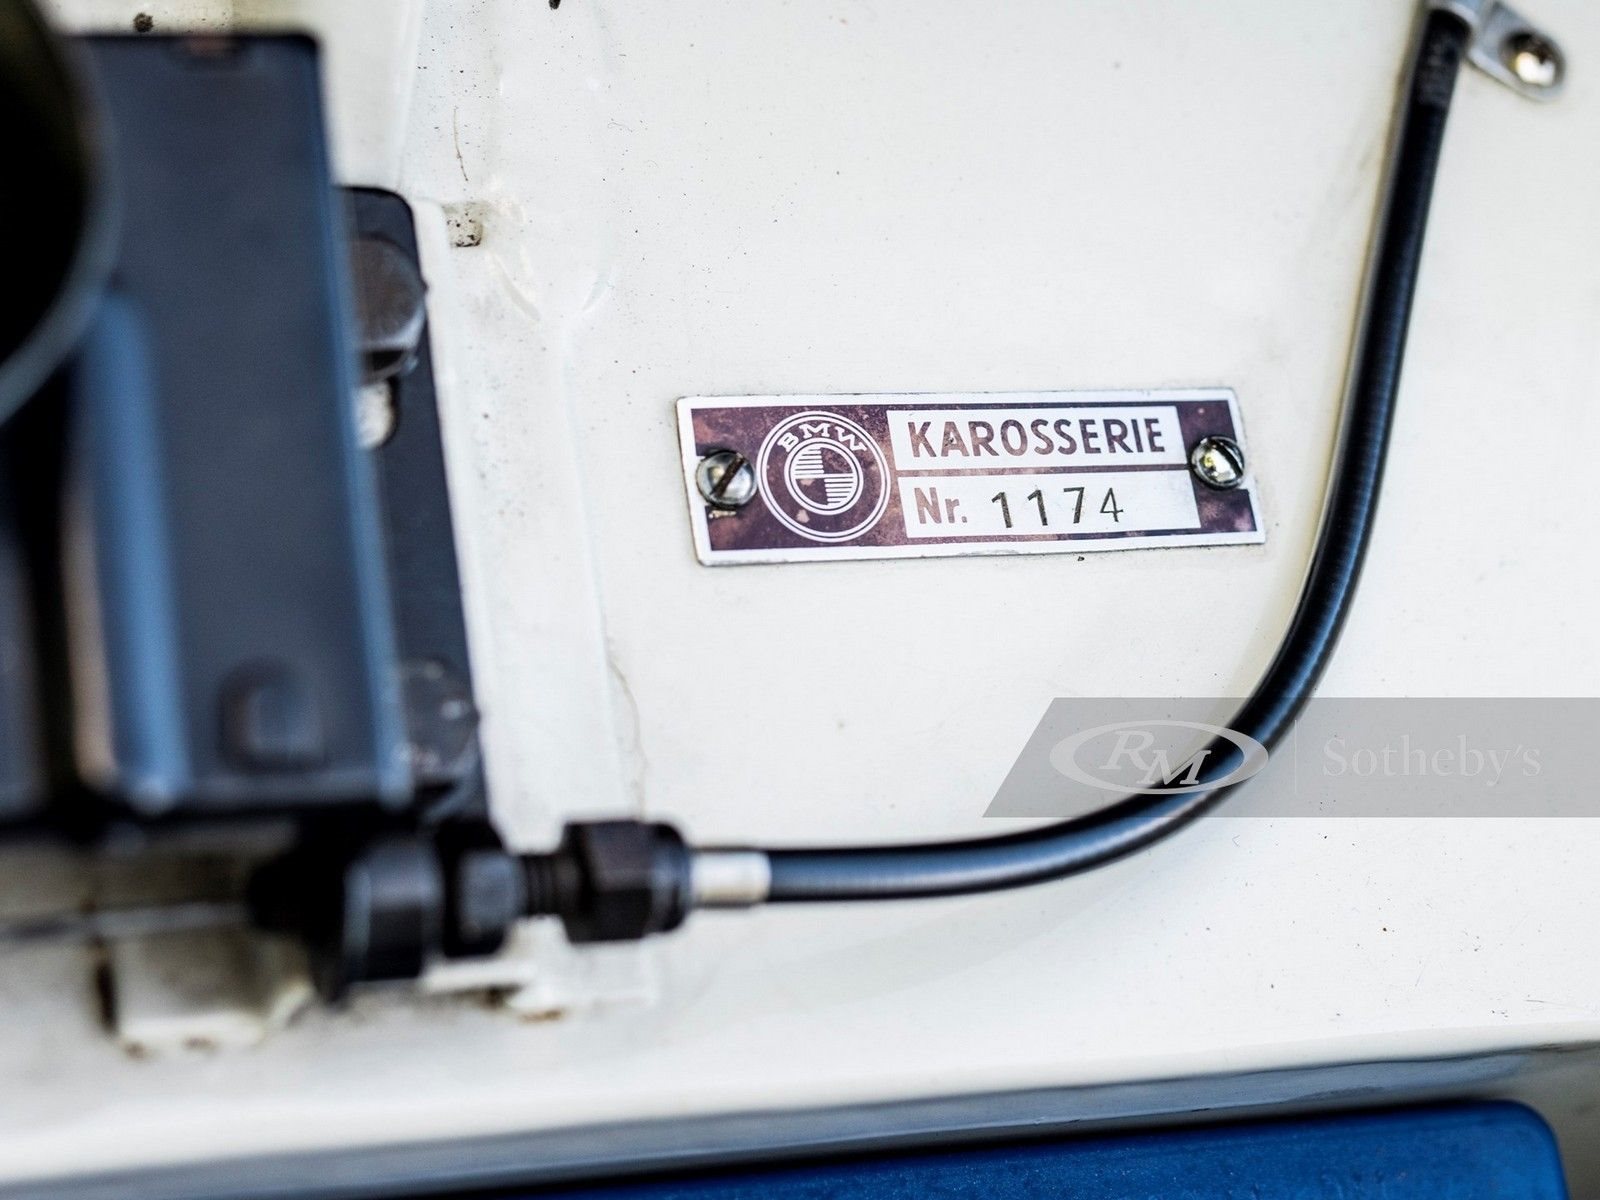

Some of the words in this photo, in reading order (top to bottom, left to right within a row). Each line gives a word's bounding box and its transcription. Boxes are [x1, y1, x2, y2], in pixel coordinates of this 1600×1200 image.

[780, 422, 867, 455] BMW
[907, 417, 1166, 459] KAROSSERIE
[914, 487, 968, 525] Nr.
[991, 486, 1124, 529] 1174
